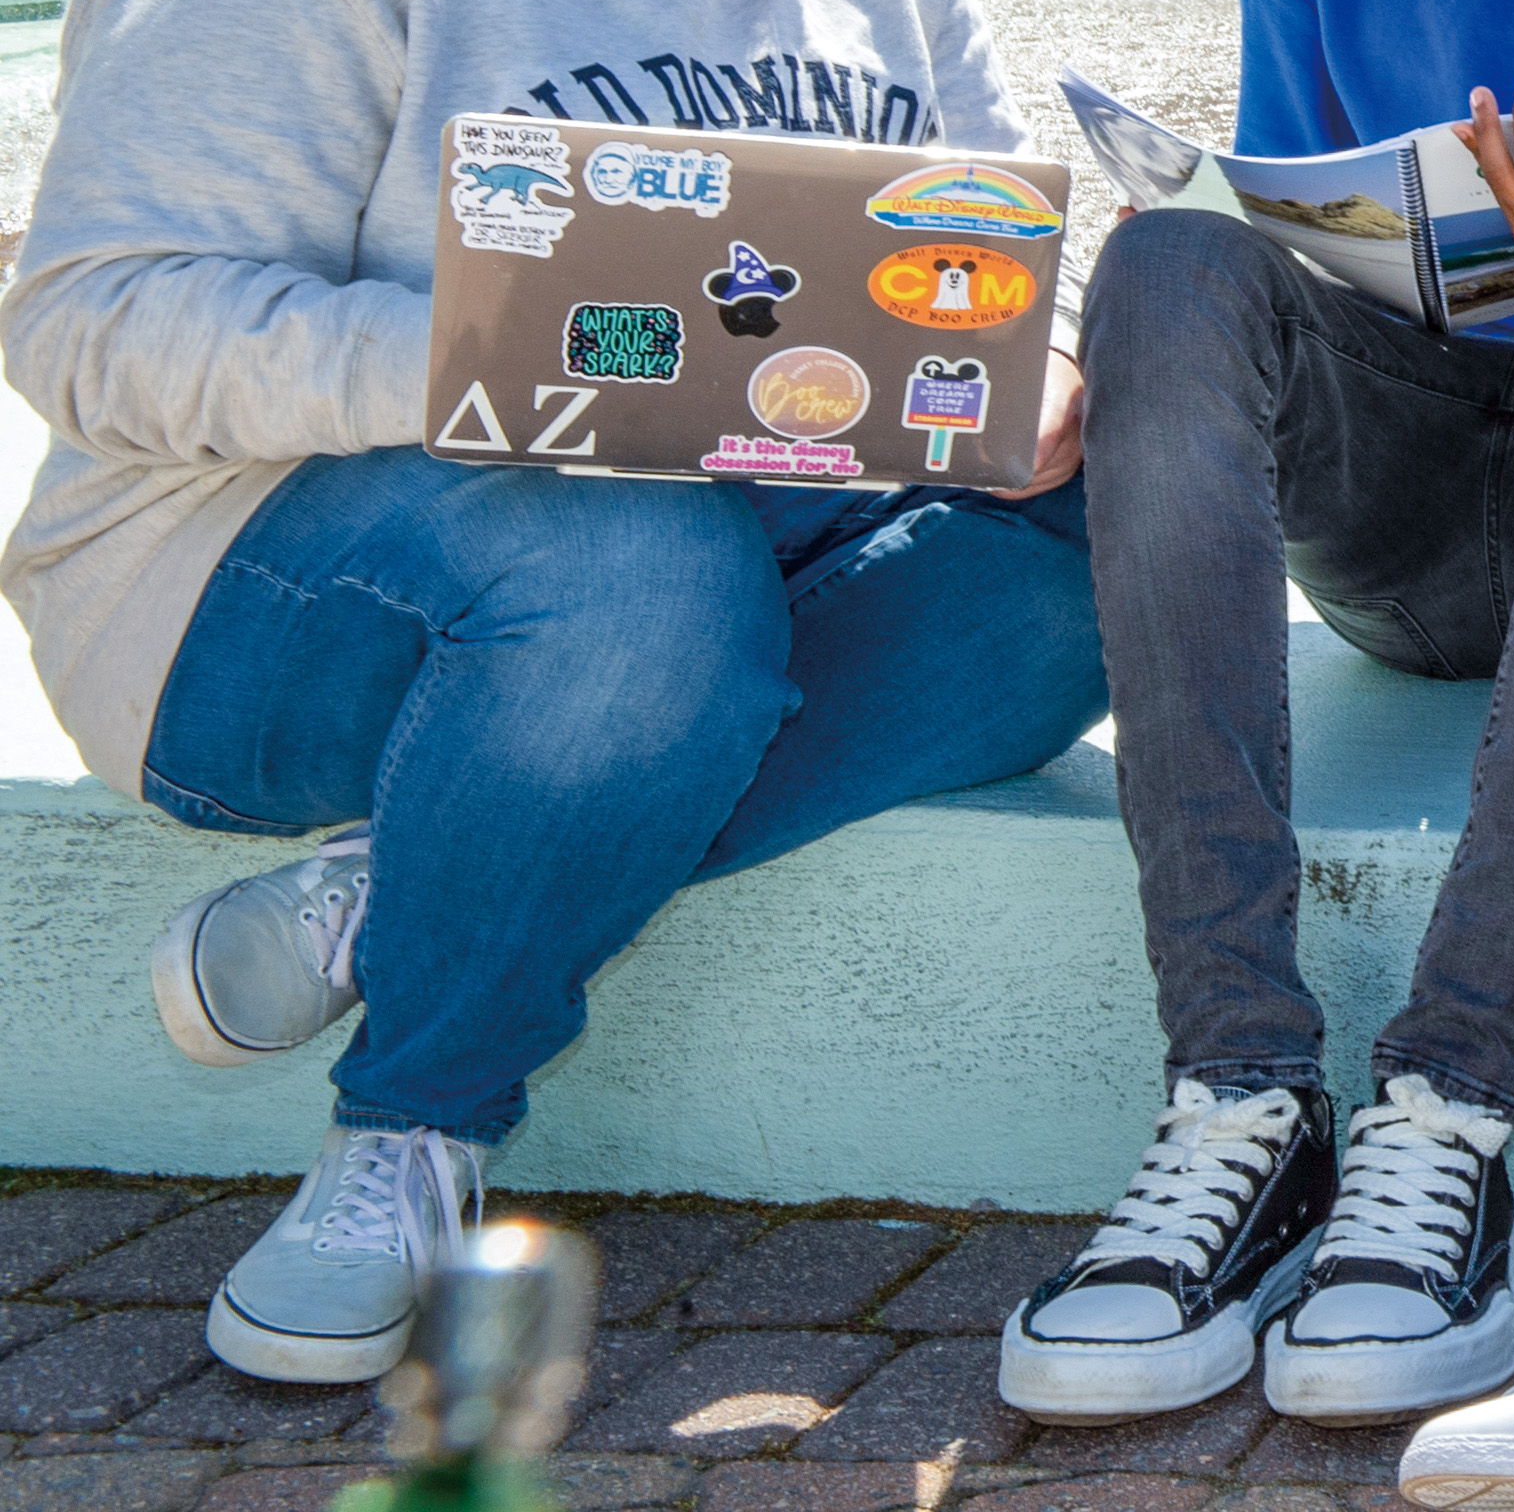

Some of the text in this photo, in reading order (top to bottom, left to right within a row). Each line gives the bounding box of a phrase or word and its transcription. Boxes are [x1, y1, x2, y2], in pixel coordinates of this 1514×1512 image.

[462, 124, 553, 144] HAVE YOU SEEN
[460, 141, 563, 163] THIS DINOSAUR?
[680, 157, 696, 170] MY
[702, 159, 725, 172] BOY
[636, 167, 720, 204] BLUE
[581, 308, 668, 332] WHAT'S
[887, 301, 1015, 324] DCP BOO CREW
[596, 330, 656, 354] YOUR
[583, 352, 676, 379] SPARK?
[919, 388, 975, 399] DREAMS
[926, 397, 966, 407] COME
[927, 405, 962, 414] TRUE
[721, 438, 851, 463] it's the disney
[703, 455, 860, 475] obsession for me
